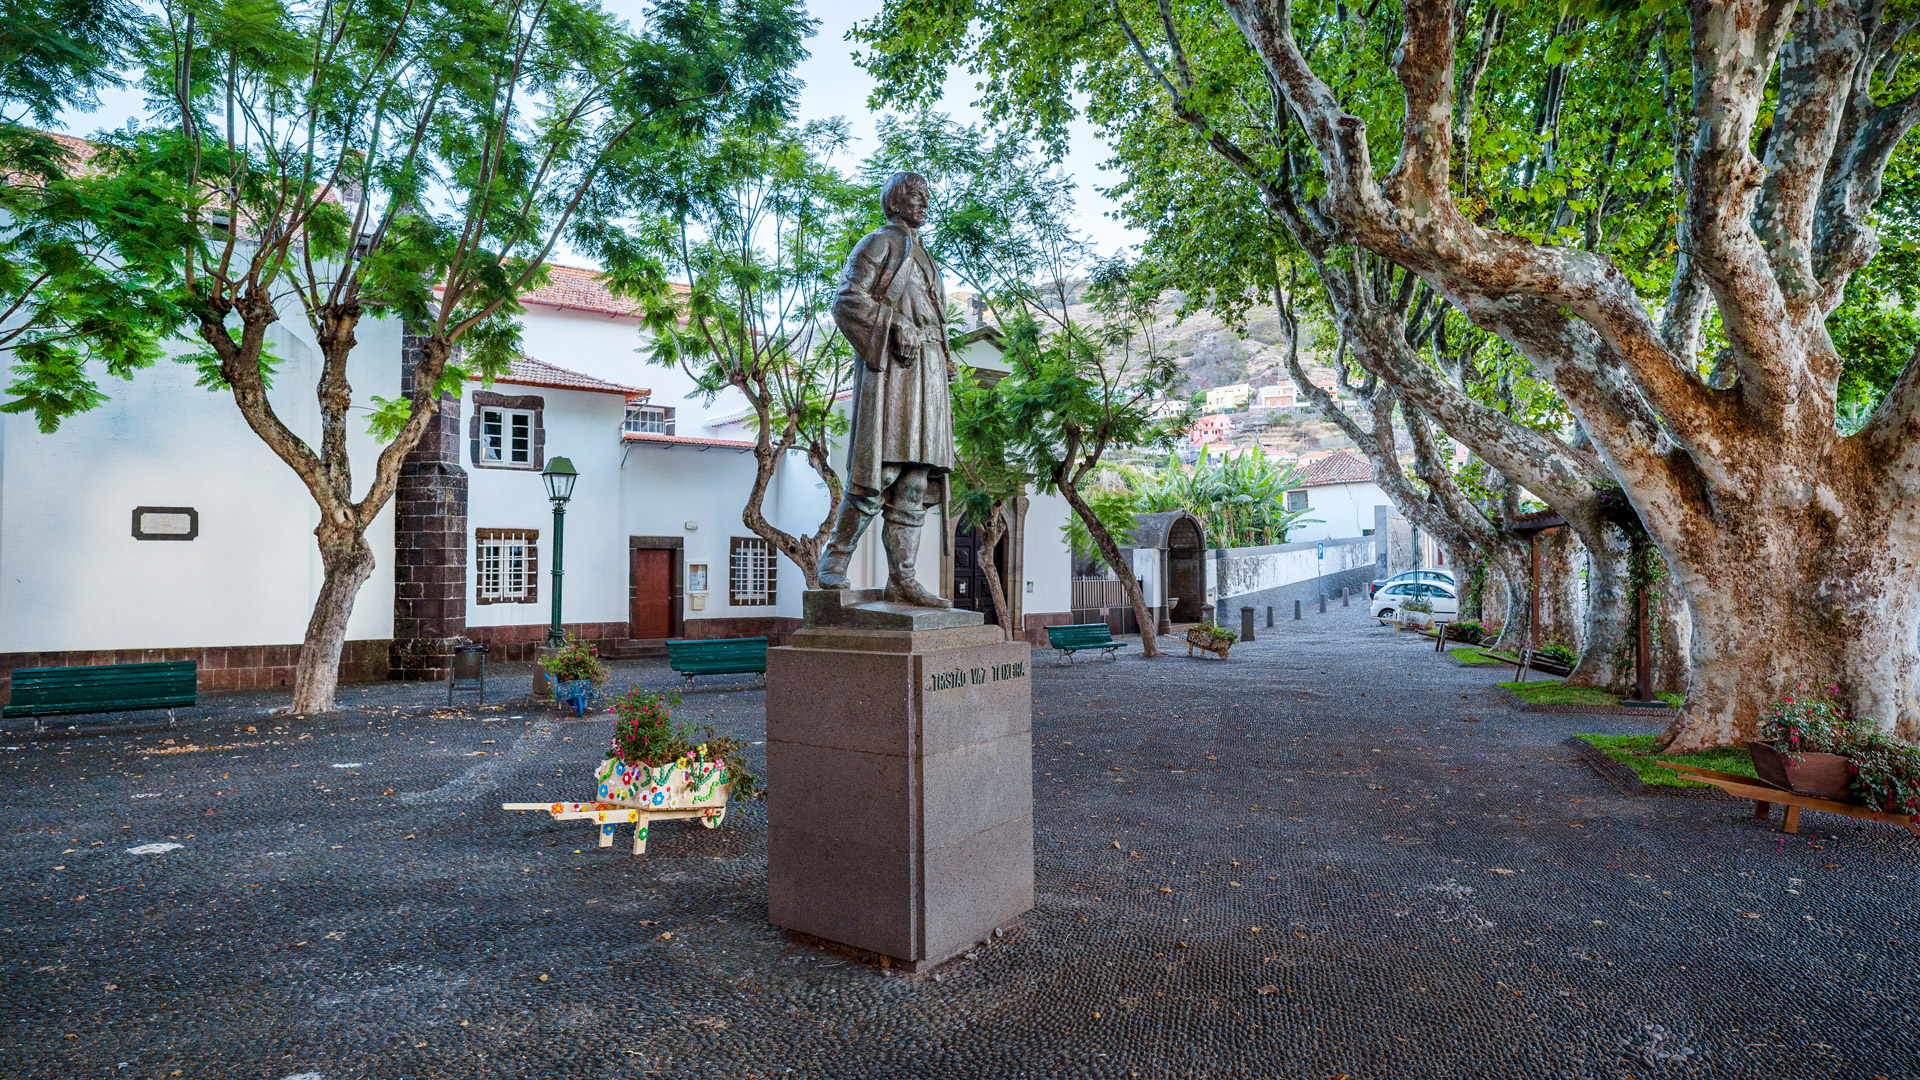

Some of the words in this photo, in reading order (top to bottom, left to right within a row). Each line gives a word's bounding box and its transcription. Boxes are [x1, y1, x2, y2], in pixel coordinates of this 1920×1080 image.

[1318, 544, 1323, 557] P
[932, 667, 968, 691] TRISTÃO
[971, 666, 988, 685] VAZ
[992, 661, 1025, 681] TEIXEIRA
